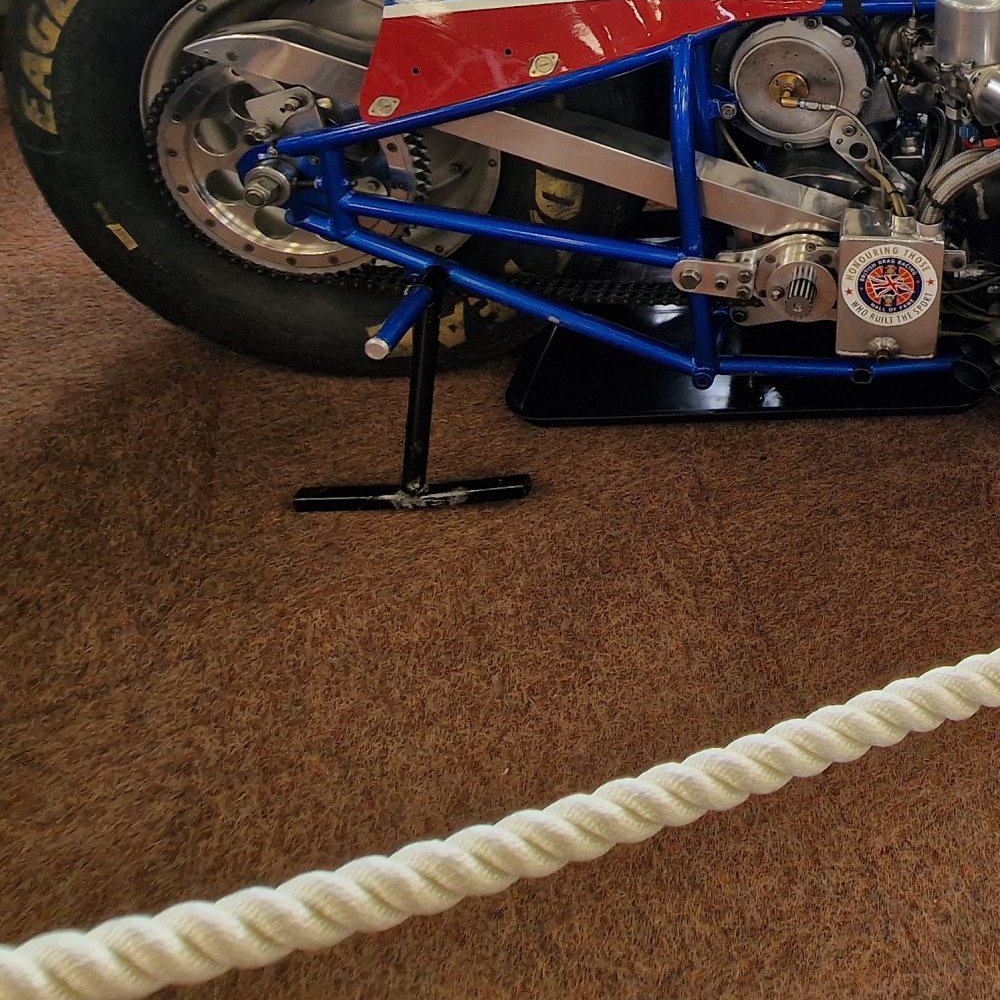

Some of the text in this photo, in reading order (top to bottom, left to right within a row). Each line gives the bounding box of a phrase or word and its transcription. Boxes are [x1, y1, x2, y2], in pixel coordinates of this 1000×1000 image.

[845, 246, 931, 281] HONOURING THOSE
[859, 263, 877, 283] BRITISH
[897, 258, 918, 277] RACING
[851, 292, 934, 324] WHO BUILT THE SPORT
[870, 302, 886, 312] HALL
[899, 299, 915, 310] FAME
